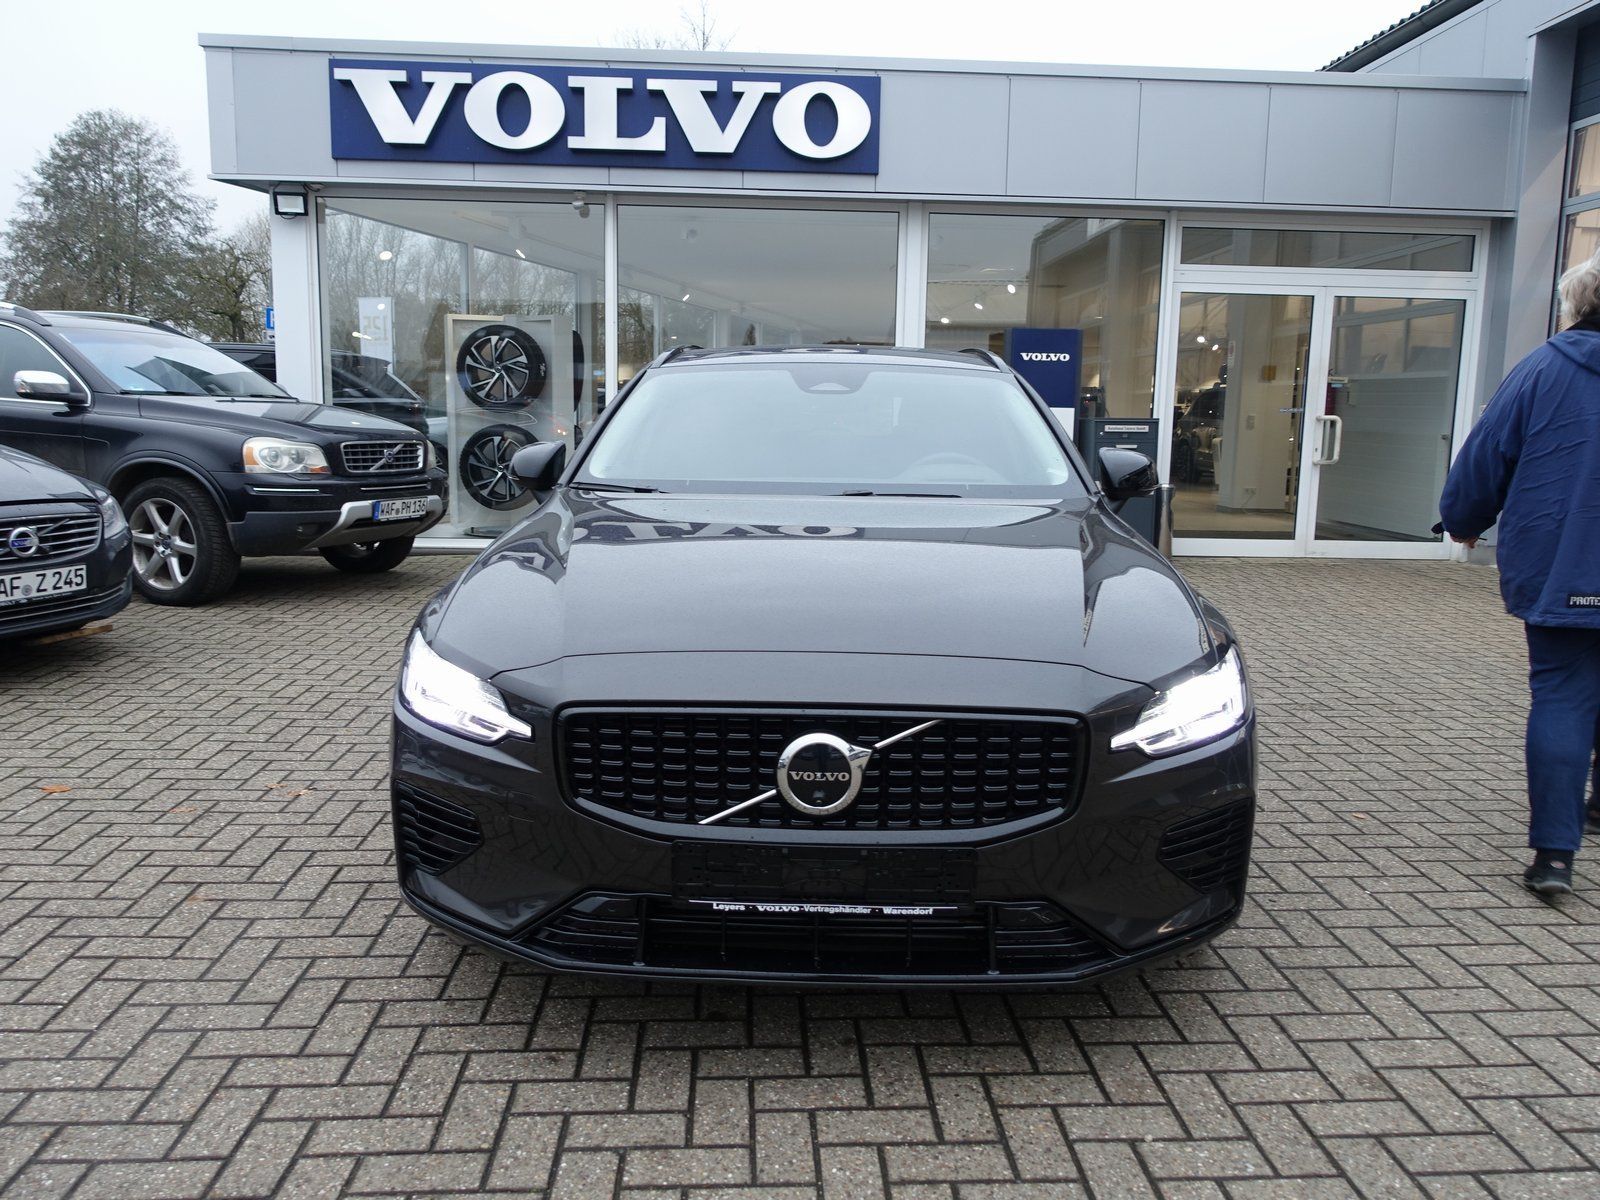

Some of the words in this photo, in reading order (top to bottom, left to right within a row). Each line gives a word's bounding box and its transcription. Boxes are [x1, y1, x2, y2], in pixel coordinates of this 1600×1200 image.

[333, 67, 872, 160] VOLVO
[1019, 352, 1071, 362] VOLVO
[36, 573, 48, 593] Z
[52, 567, 84, 591] 245
[788, 771, 850, 781] VOLVO
[712, 902, 746, 911] Leyers
[882, 907, 934, 915] Warendorf
